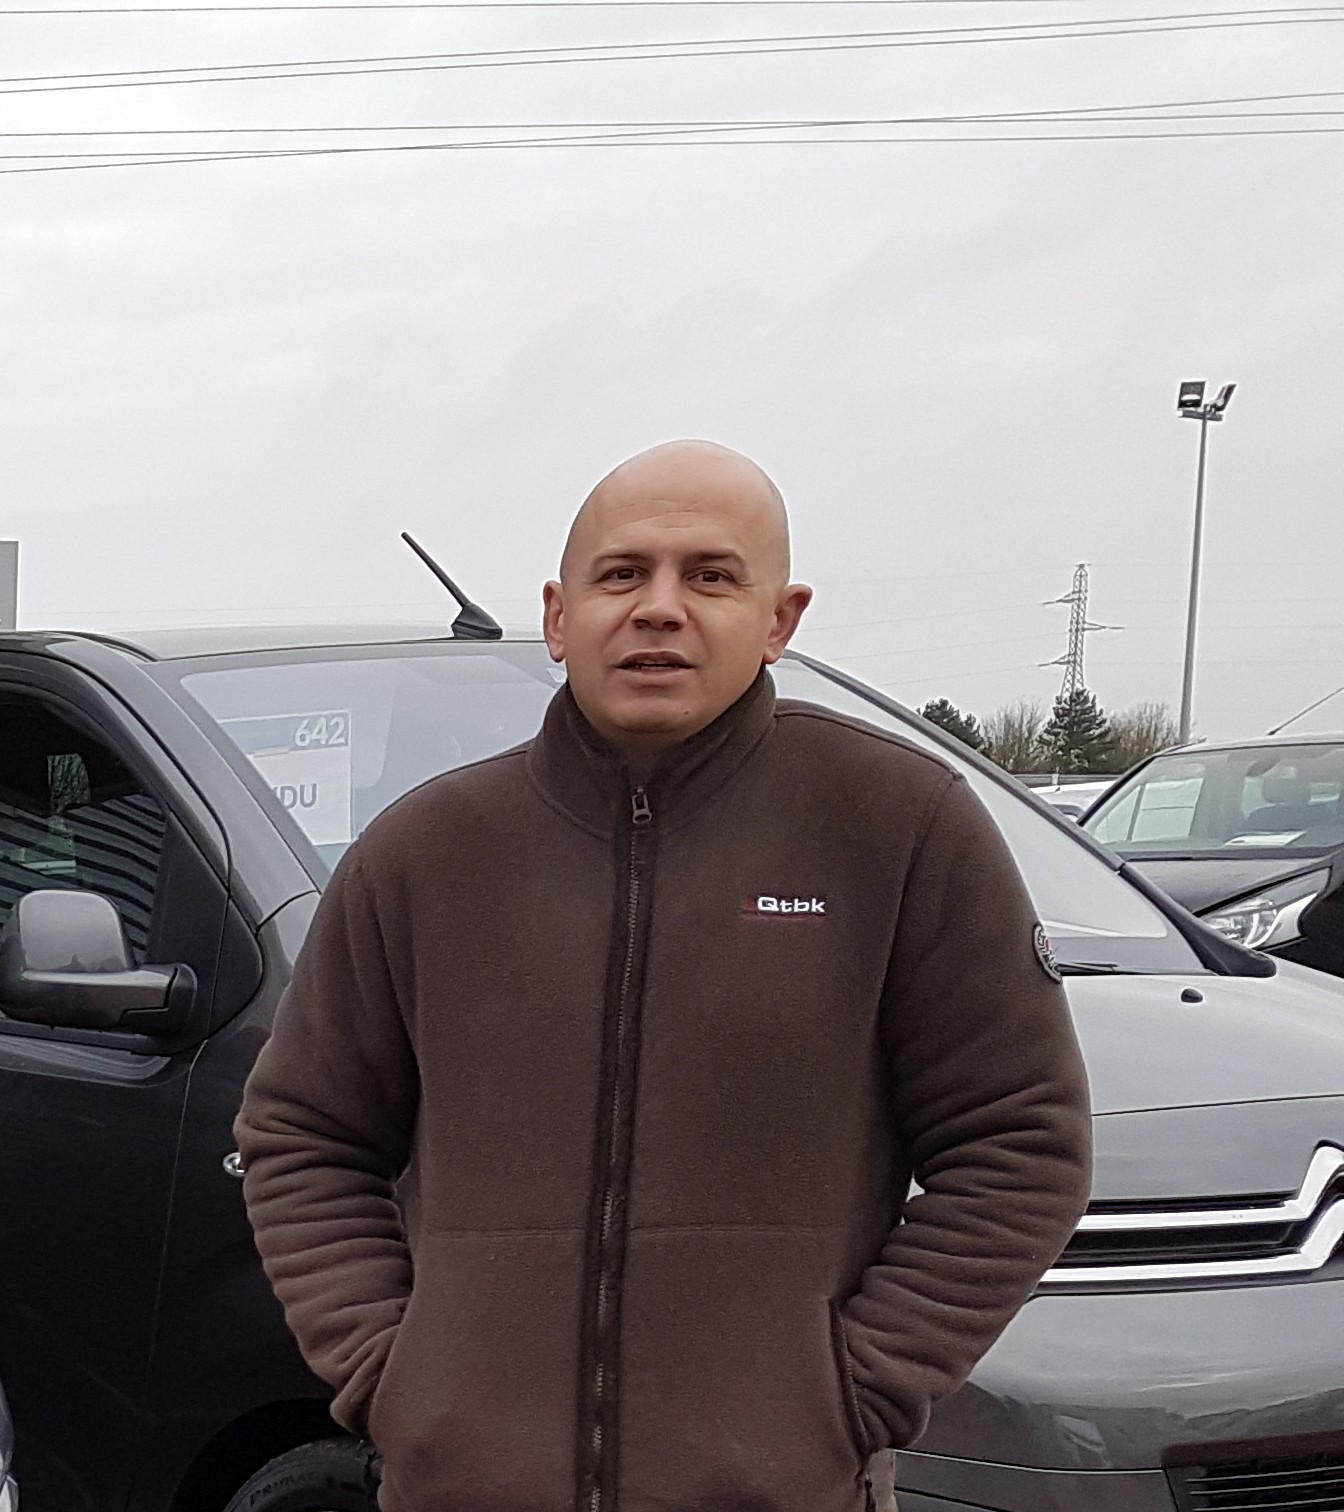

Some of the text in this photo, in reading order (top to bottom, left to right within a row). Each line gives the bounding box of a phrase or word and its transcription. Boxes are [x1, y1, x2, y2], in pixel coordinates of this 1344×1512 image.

[295, 716, 345, 747] 642
[273, 783, 317, 809] DU
[757, 895, 826, 913] Qtbk
